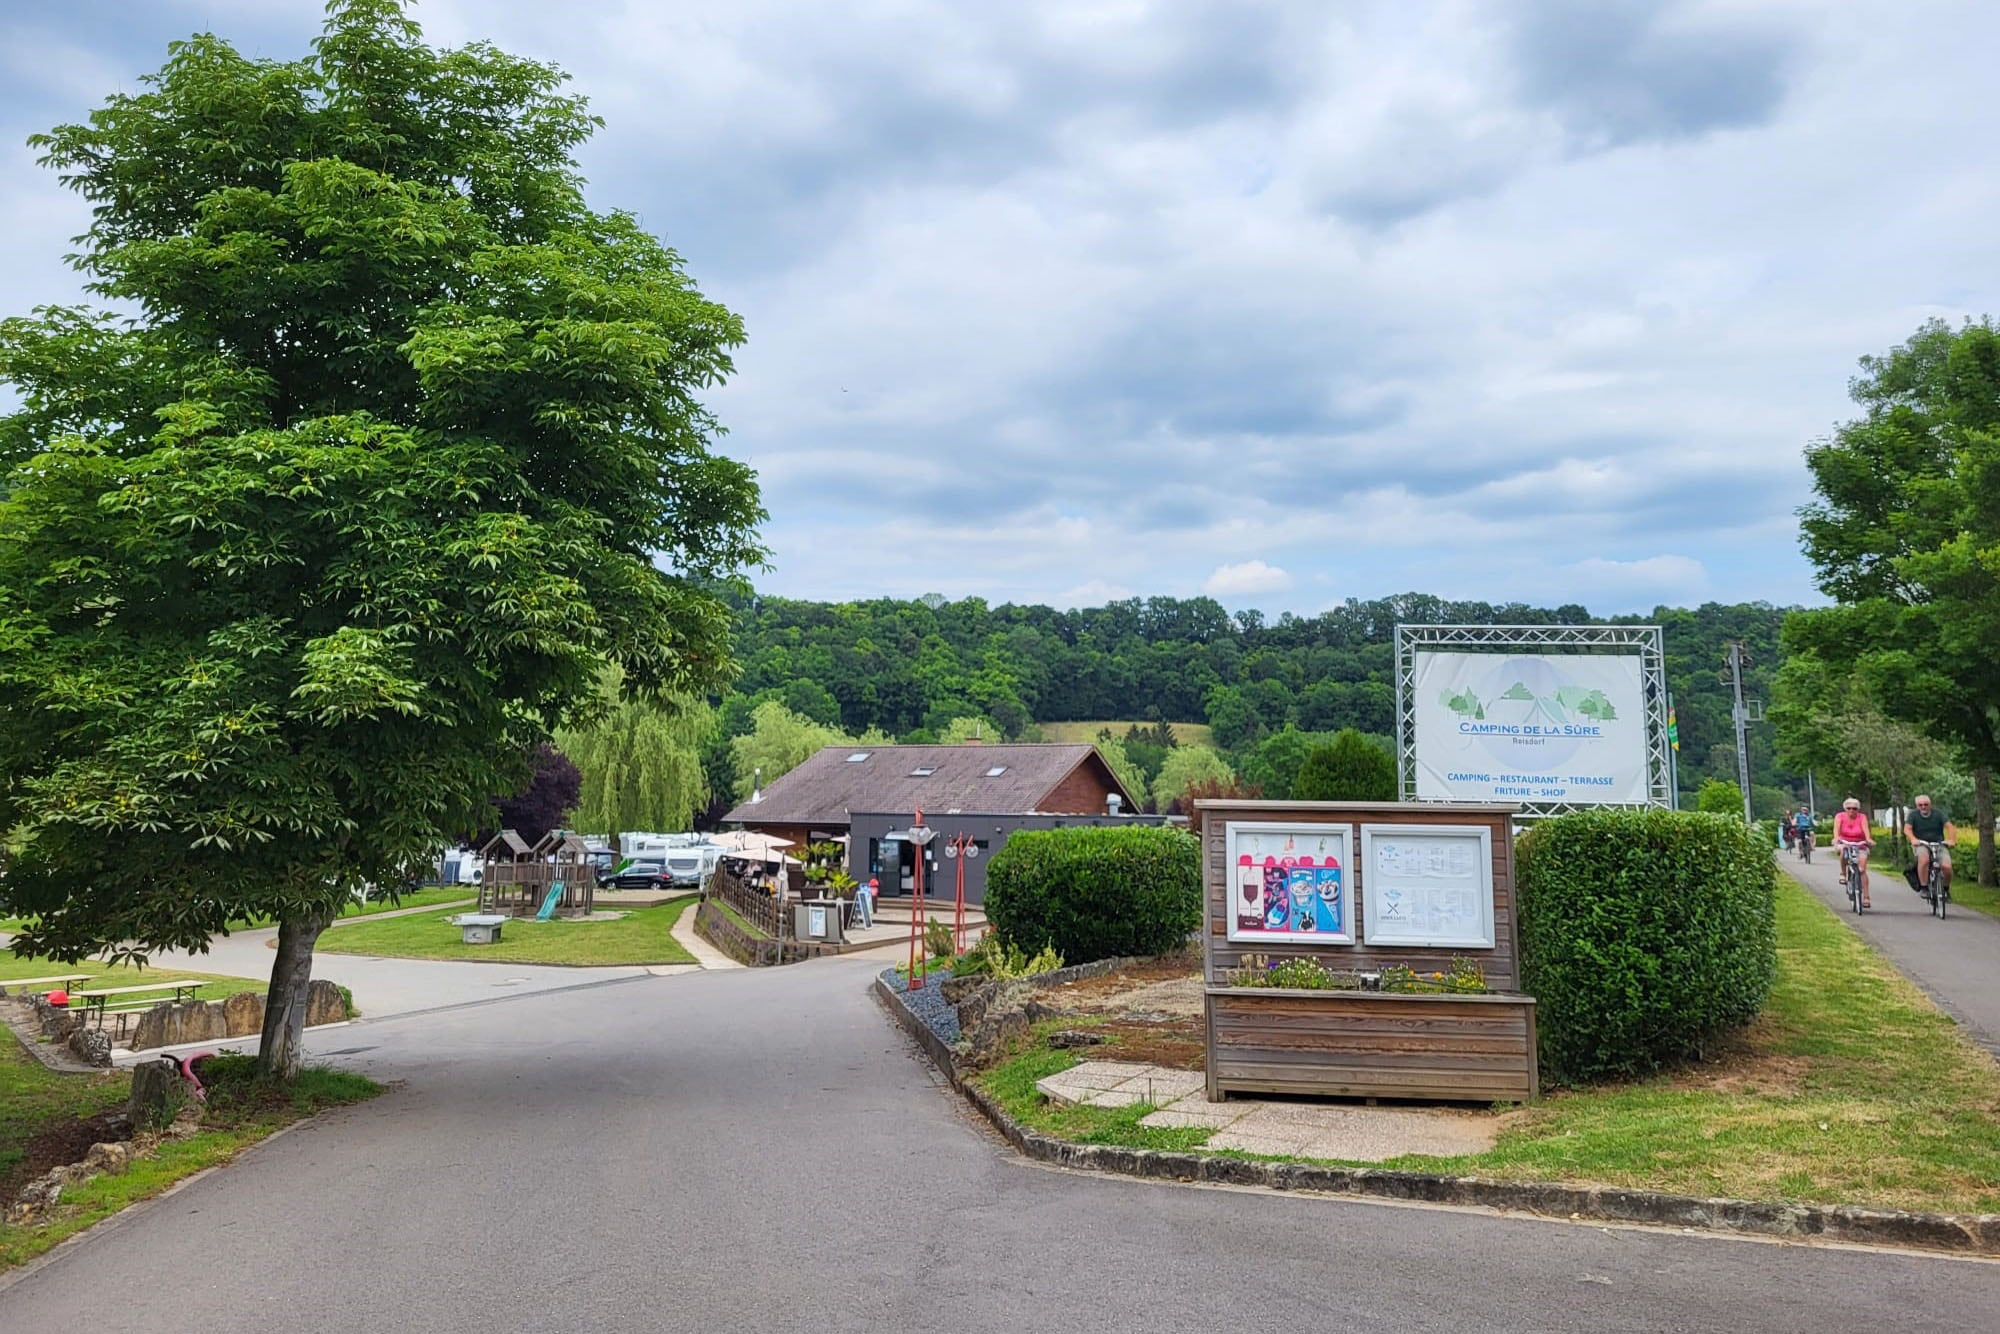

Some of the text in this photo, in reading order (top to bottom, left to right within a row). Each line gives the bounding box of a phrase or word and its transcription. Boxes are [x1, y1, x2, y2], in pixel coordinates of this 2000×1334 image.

[1459, 721, 1601, 736] CAMPING DE LA SÛRE
[1447, 772, 1490, 783] CAMPING
[1500, 774, 1558, 785] RESTAURANT
[1569, 776, 1614, 786] TERRASSE
[1494, 786, 1531, 797] FRITURE
[1541, 787, 1566, 797] SHOP
